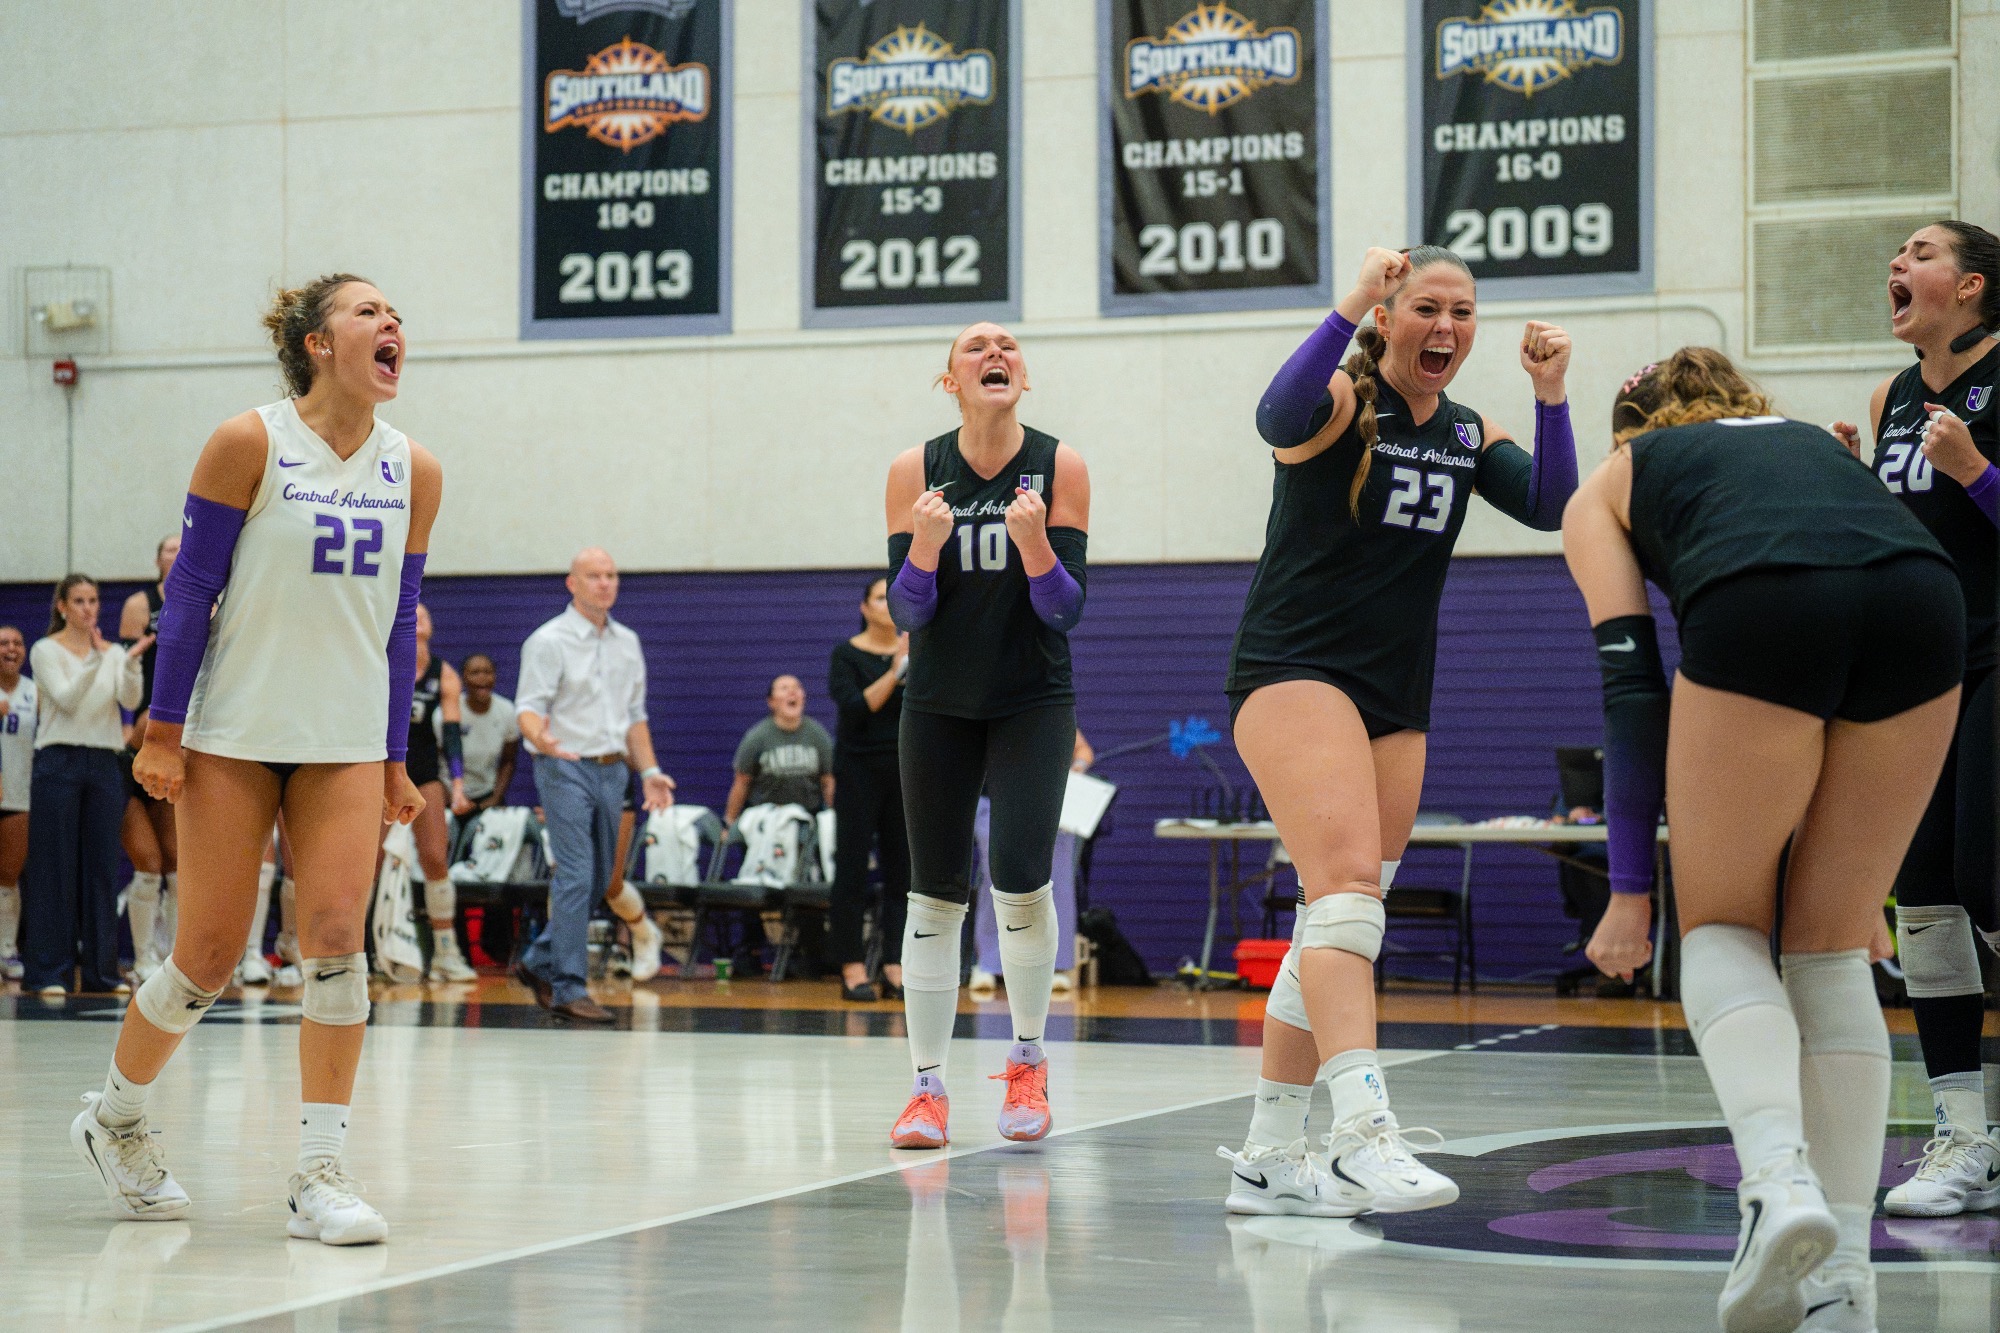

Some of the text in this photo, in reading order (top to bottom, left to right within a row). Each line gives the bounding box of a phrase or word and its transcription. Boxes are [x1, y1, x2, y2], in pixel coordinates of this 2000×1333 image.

[1130, 33, 1297, 90] SOUTHLAND
[1442, 13, 1619, 69] SOUTHLAND
[549, 67, 706, 122] SOUTHLAND
[832, 56, 989, 108] SOUTHLAND
[1122, 132, 1304, 170] CHAMPIONS
[1434, 115, 1625, 152] CHAMPIONS
[544, 168, 709, 200] CHAMPIONS
[825, 152, 997, 185] CHAMPIONS
[1183, 170, 1244, 198] 15-1
[1496, 153, 1562, 182] 16-0
[880, 187, 943, 214] 15-3
[1138, 217, 1285, 276] 2010
[1446, 203, 1614, 261] 2009
[559, 250, 693, 302] 2013
[840, 235, 981, 290] 2012
[1421, 448, 1476, 469] Arkansas
[1878, 443, 1934, 494] 20
[283, 483, 406, 510] Central Arkansas
[951, 500, 978, 517] tral
[1382, 465, 1455, 535] 23
[311, 512, 384, 578] 22
[956, 522, 1008, 572] 10
[1937, 1129, 1951, 1137] NIKE
